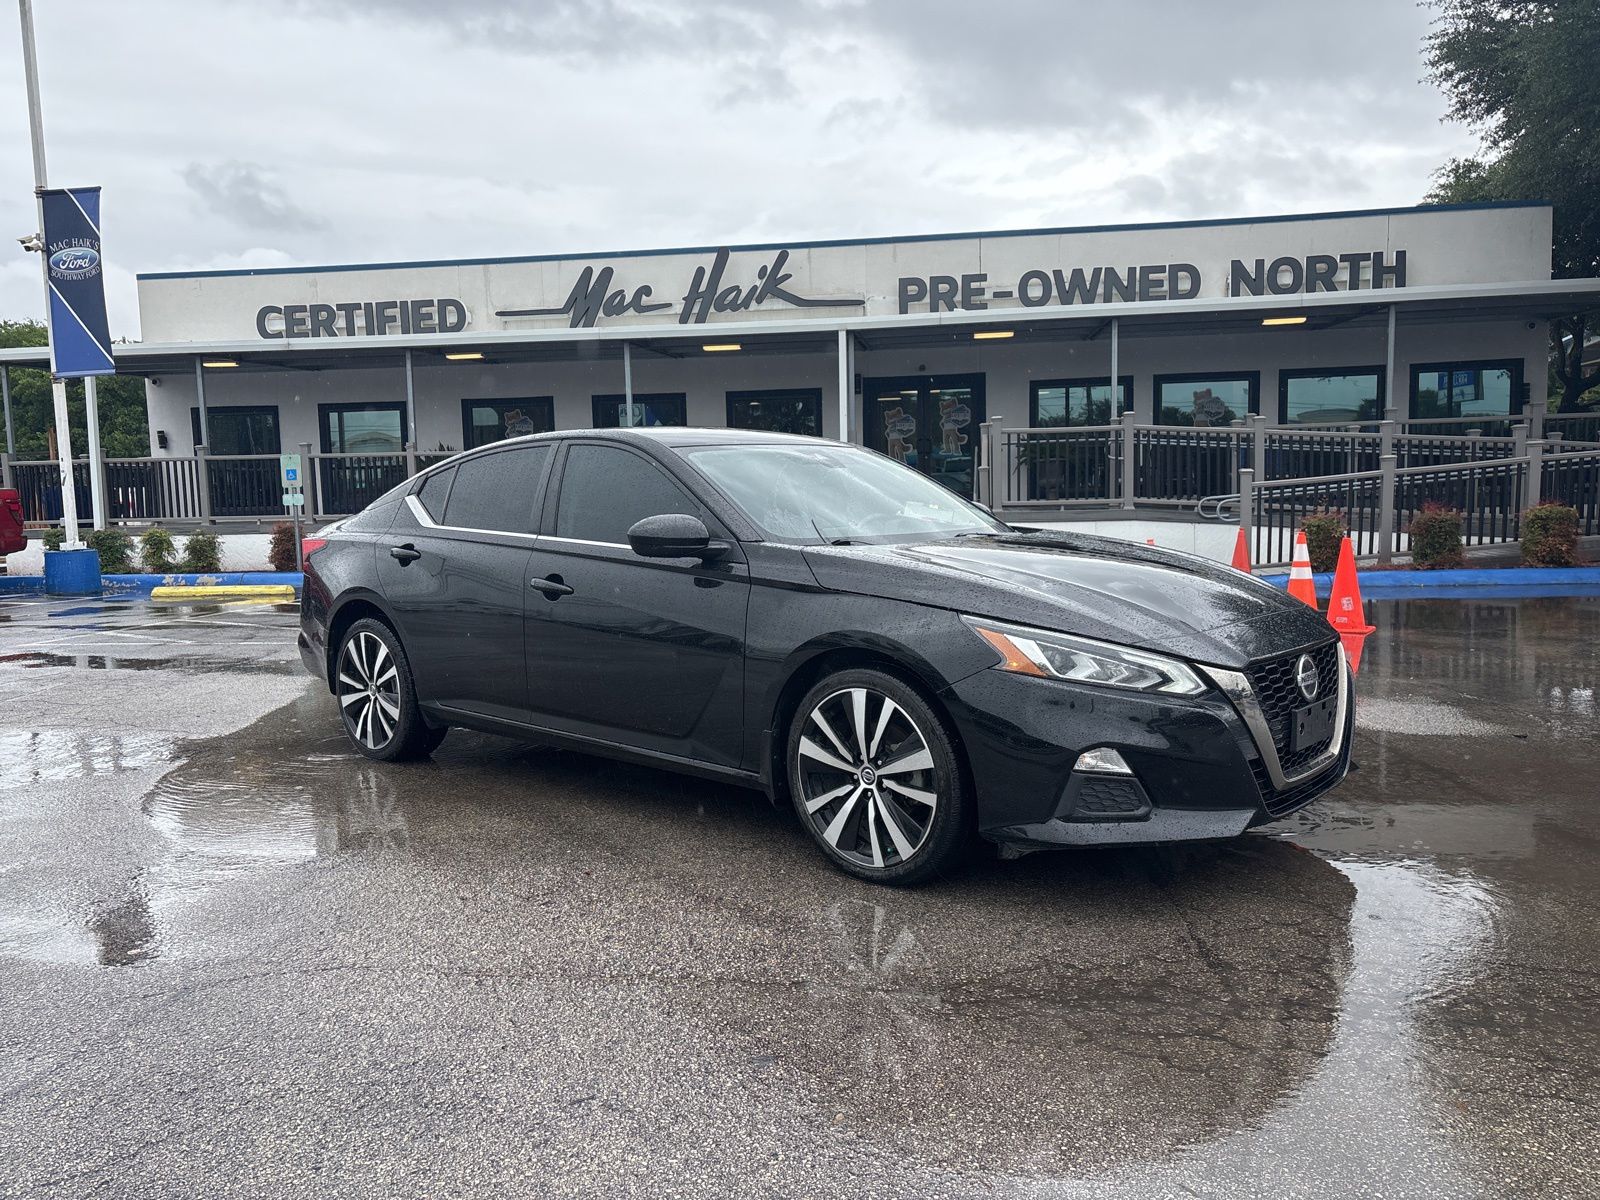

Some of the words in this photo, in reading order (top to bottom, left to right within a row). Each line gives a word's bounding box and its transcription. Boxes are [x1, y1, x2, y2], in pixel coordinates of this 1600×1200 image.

[49, 239, 70, 254] MAC
[71, 237, 100, 250] HAIK'S
[59, 251, 90, 269] Ford
[50, 270, 85, 280] SOUTHWAY
[85, 266, 100, 279] FORD
[256, 298, 467, 339] CERTIFIED
[495, 266, 672, 328] Mac
[678, 246, 866, 324] Haik
[898, 263, 1201, 315] PRE-OWNED
[1231, 250, 1407, 298] NORTH
